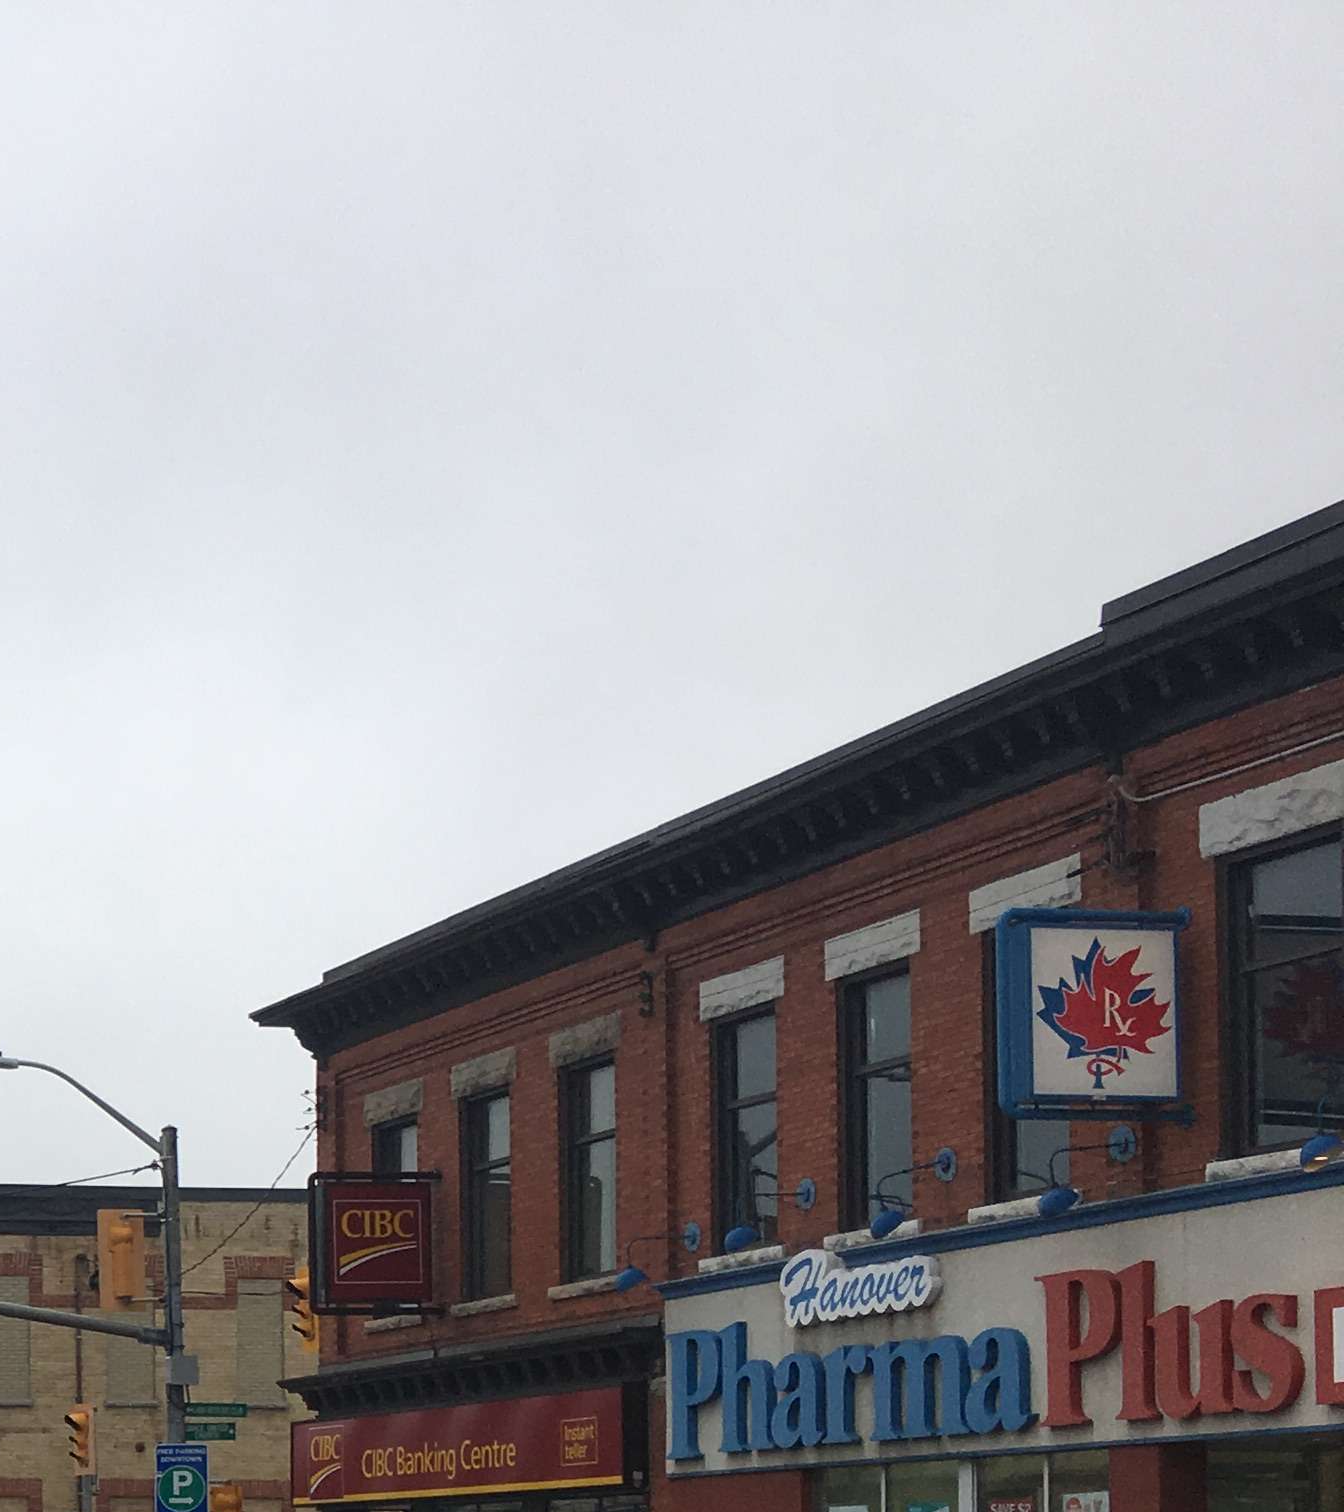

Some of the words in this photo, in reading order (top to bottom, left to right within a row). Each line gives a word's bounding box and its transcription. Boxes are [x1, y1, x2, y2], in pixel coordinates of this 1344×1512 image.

[340, 1209, 415, 1238] CIBC
[784, 1256, 926, 1320] Hanover
[666, 1321, 1040, 1461] Pharma
[1034, 1259, 1306, 1429] Plus
[564, 1423, 596, 1442] Instant
[310, 1434, 342, 1462] CIBC
[361, 1448, 394, 1479] CIBC
[395, 1442, 456, 1480] Banking
[461, 1439, 517, 1470] Centre
[565, 1443, 588, 1460] teller
[172, 1470, 193, 1496] P
